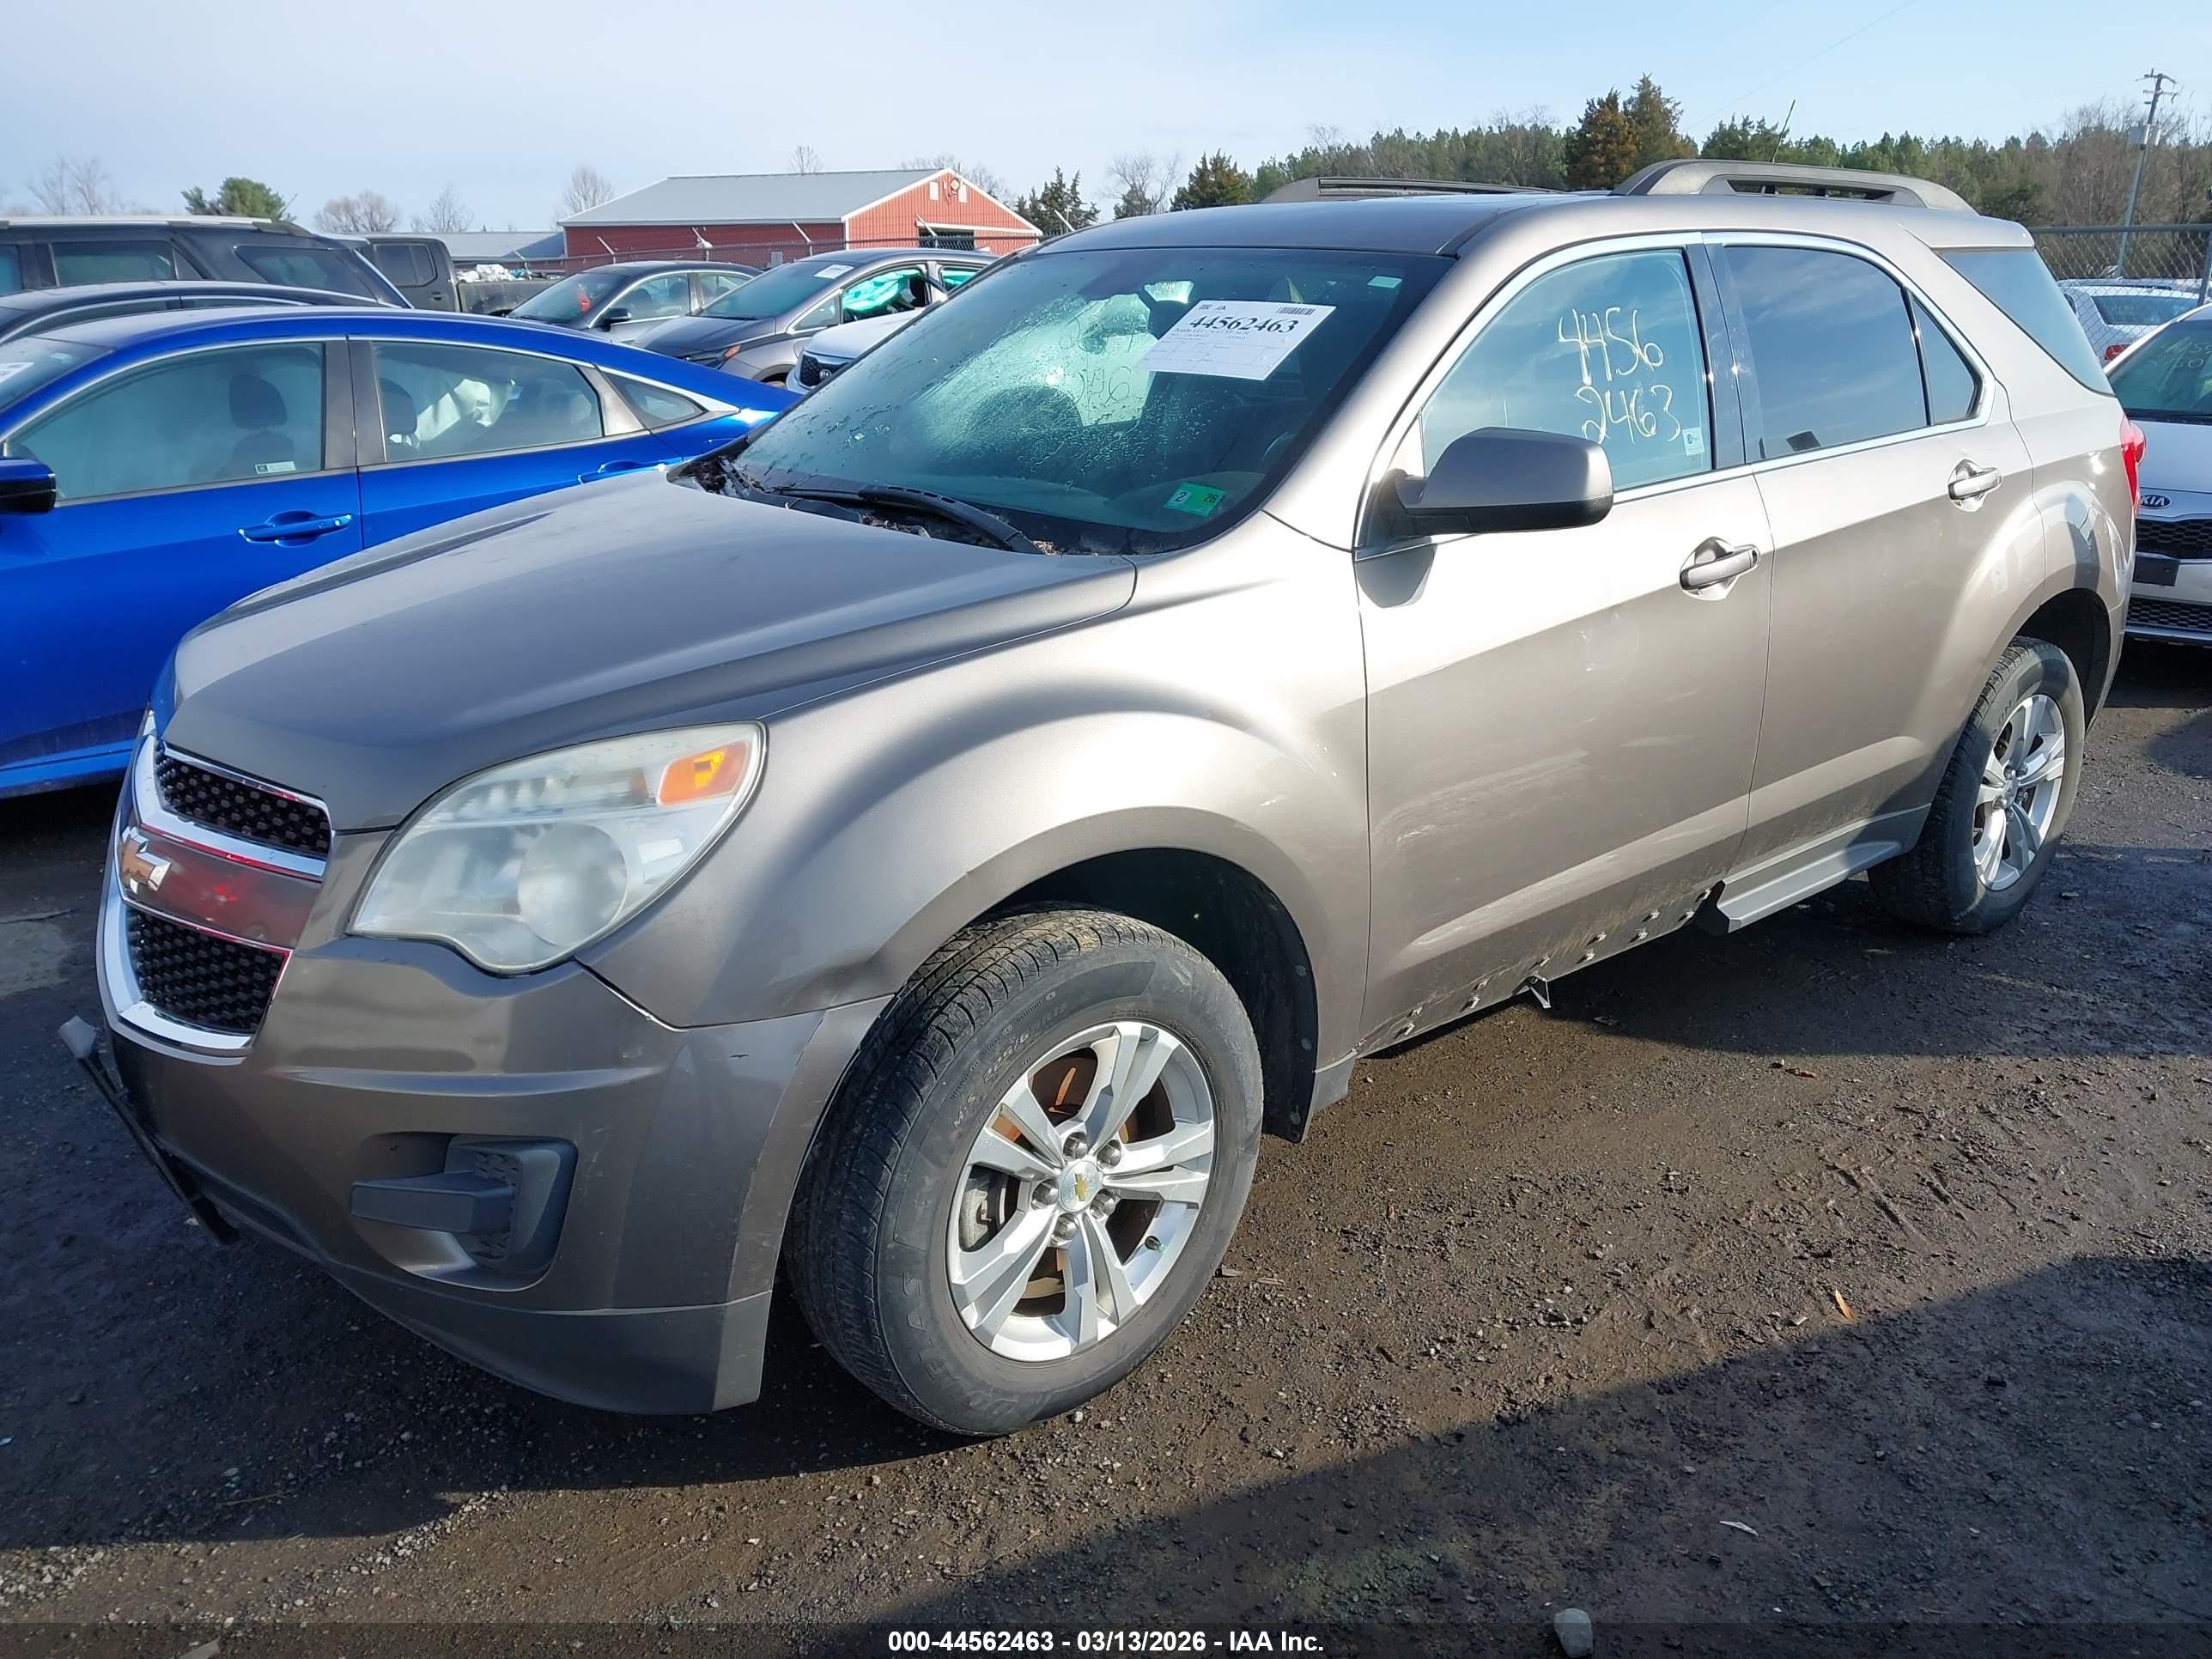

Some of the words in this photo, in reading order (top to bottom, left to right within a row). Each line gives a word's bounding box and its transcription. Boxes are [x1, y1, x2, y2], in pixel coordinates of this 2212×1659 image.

[1188, 315, 1299, 333] 44562463
[1559, 307, 1663, 386] 4456
[1574, 384, 1681, 445] 2463
[1175, 491, 1188, 502] 2
[1203, 494, 1219, 503] 26
[2141, 494, 2166, 507] KIA
